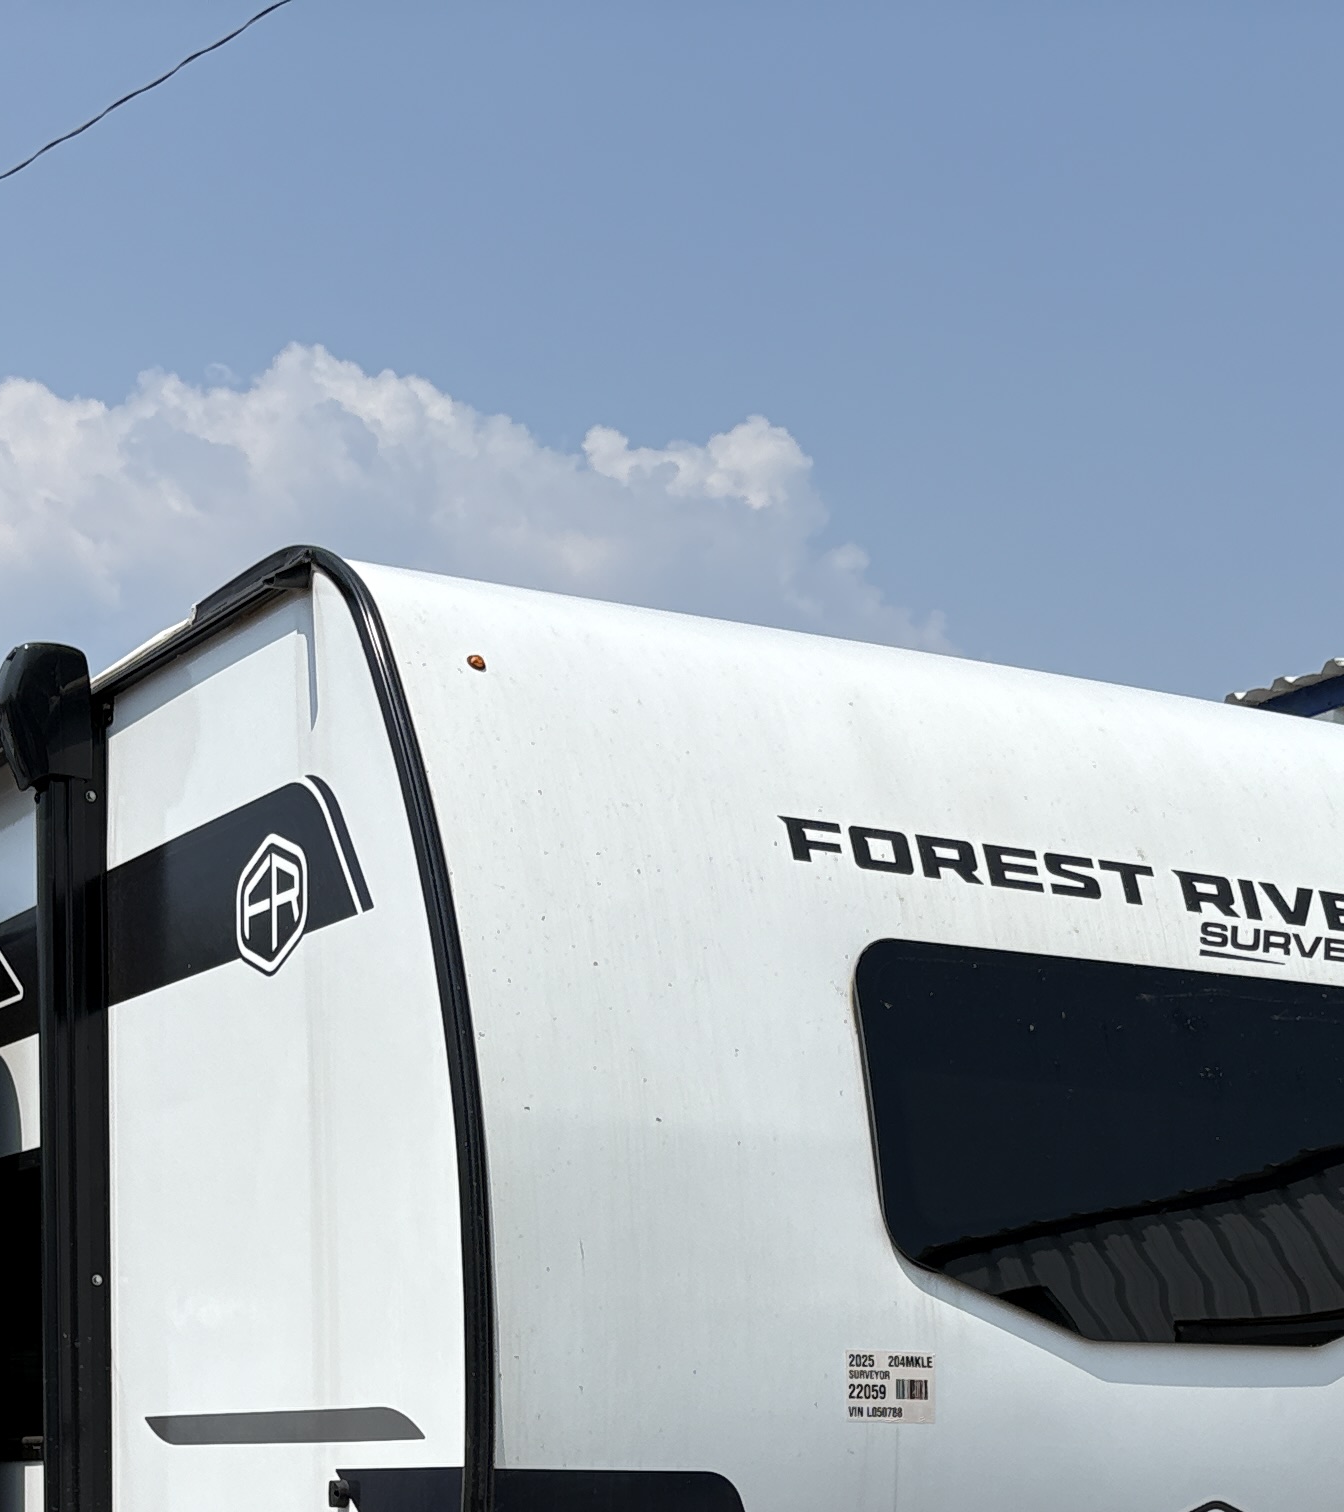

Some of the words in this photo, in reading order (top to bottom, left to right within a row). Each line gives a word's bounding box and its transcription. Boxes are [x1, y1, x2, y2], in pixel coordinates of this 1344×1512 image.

[777, 815, 1154, 905] FOREST
[848, 1354, 875, 1368] 2025
[887, 1355, 934, 1369] 204MKLE
[848, 1369, 891, 1380] SURVEYOR
[848, 1383, 887, 1400] 22059
[848, 1405, 864, 1418] VIN
